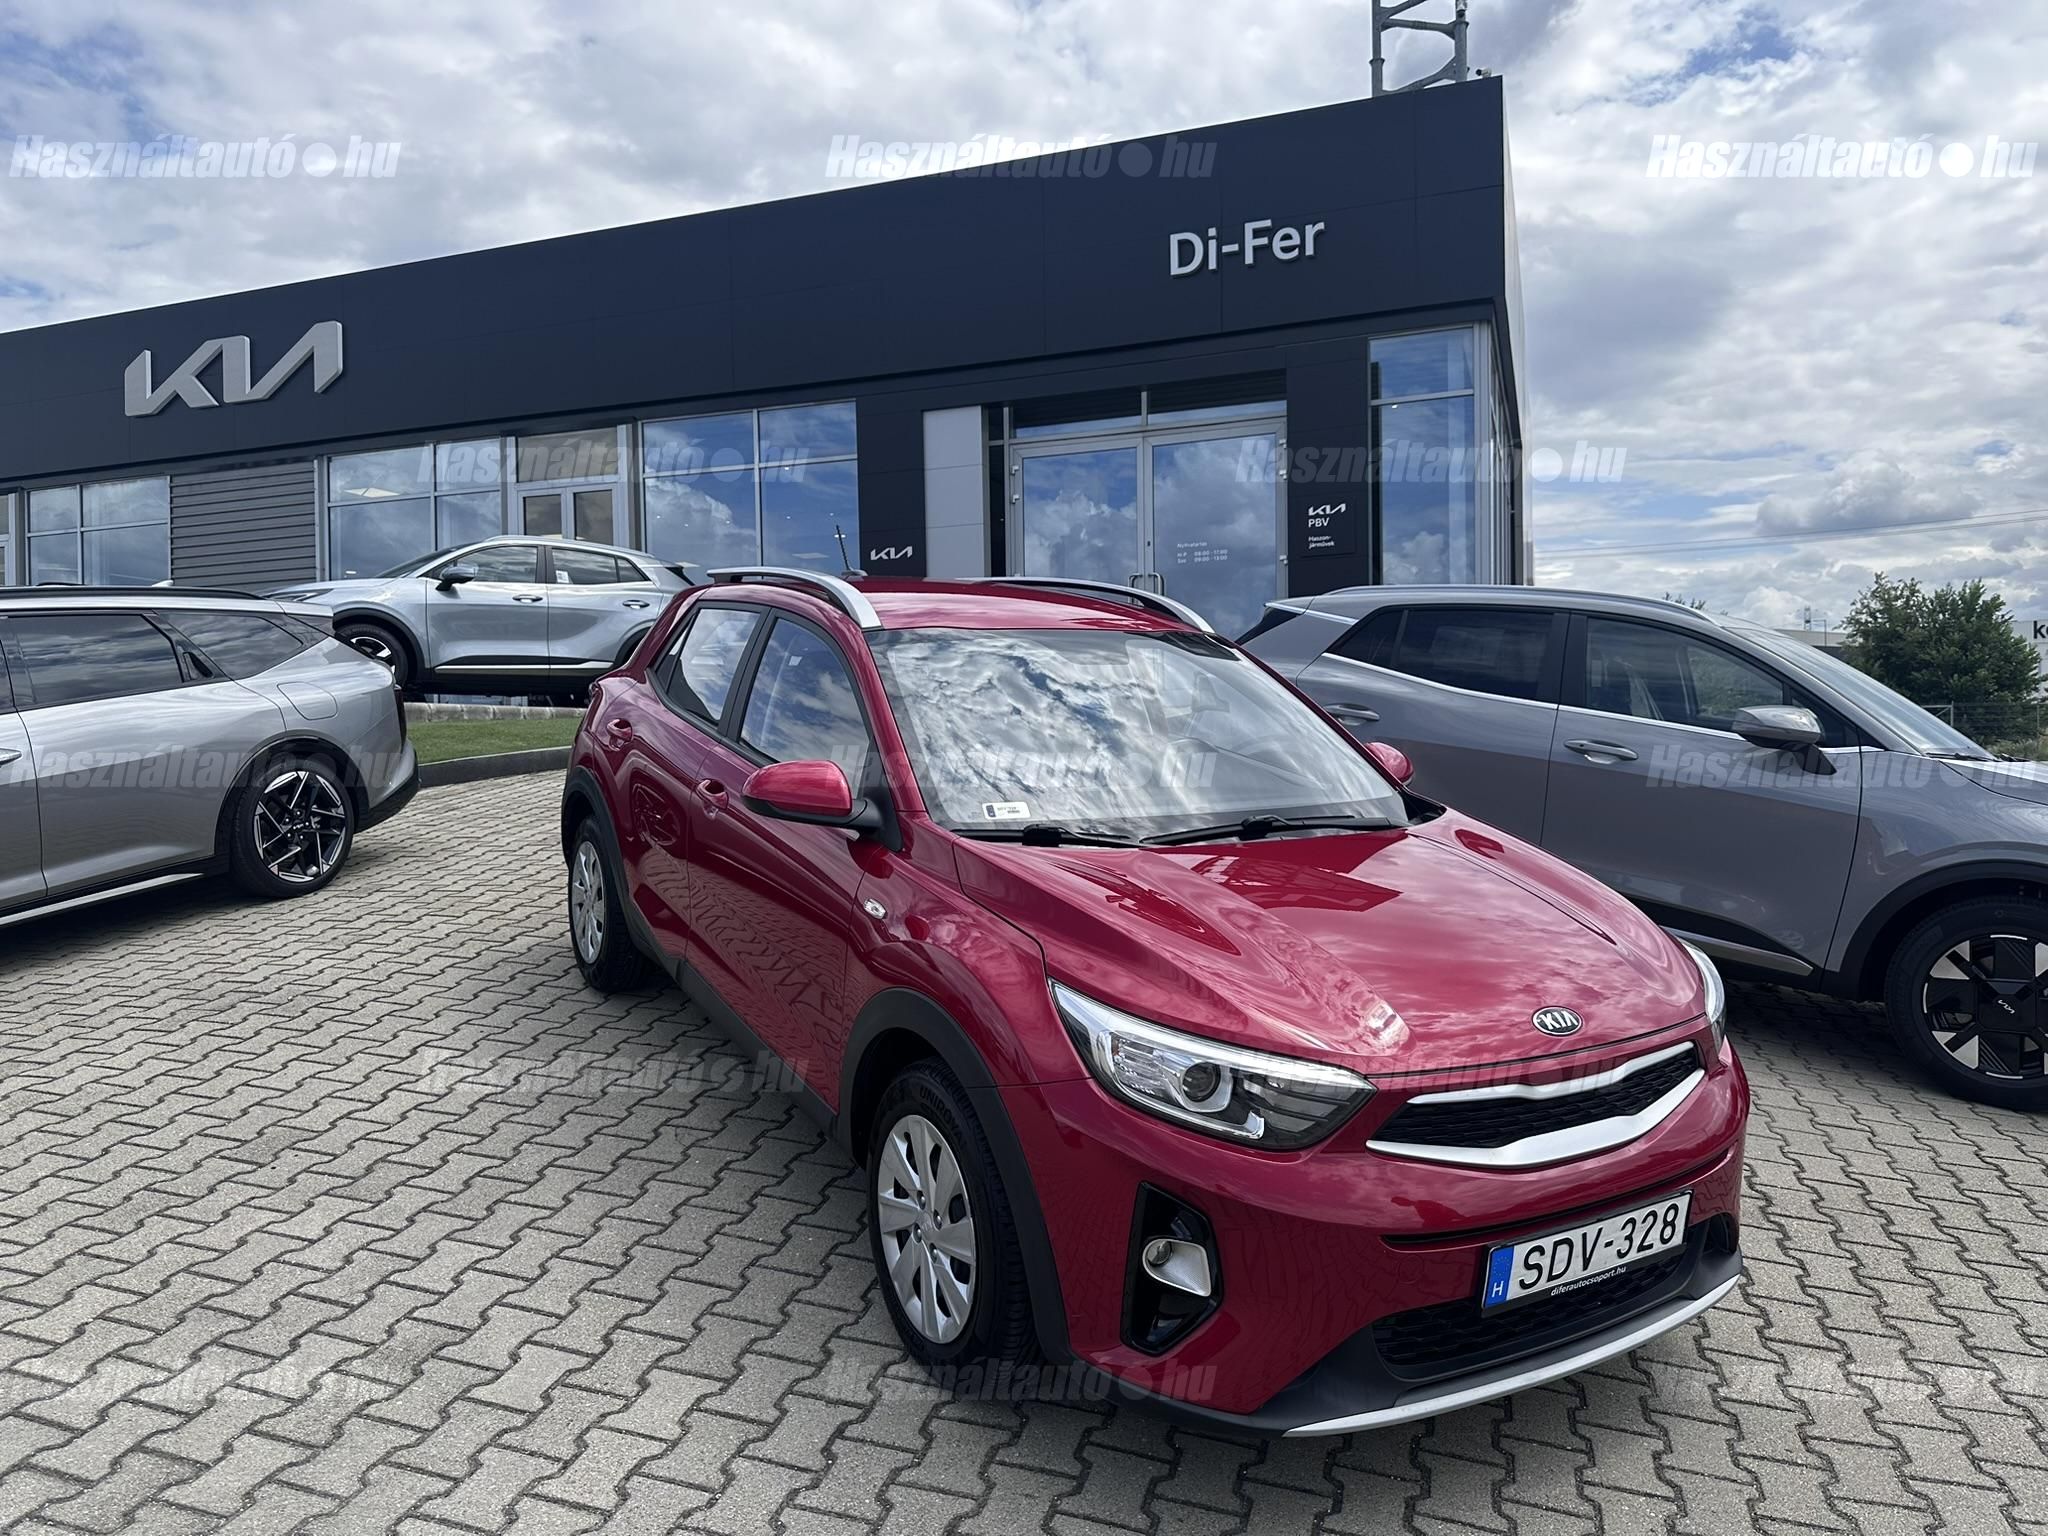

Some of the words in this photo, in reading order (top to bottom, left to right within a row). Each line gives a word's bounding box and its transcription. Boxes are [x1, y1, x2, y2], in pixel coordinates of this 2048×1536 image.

[1169, 218, 1326, 276] Di-Fer
[124, 320, 343, 417] KIA
[1308, 517, 1330, 528] PBV
[870, 546, 913, 561] KIA
[2033, 620, 2048, 639] k
[1538, 1010, 1579, 1030] KIA
[1518, 1203, 1680, 1290] SDV-328
[1491, 1280, 1505, 1298] H
[1550, 1265, 1627, 1296] diferautocsoport.hu
